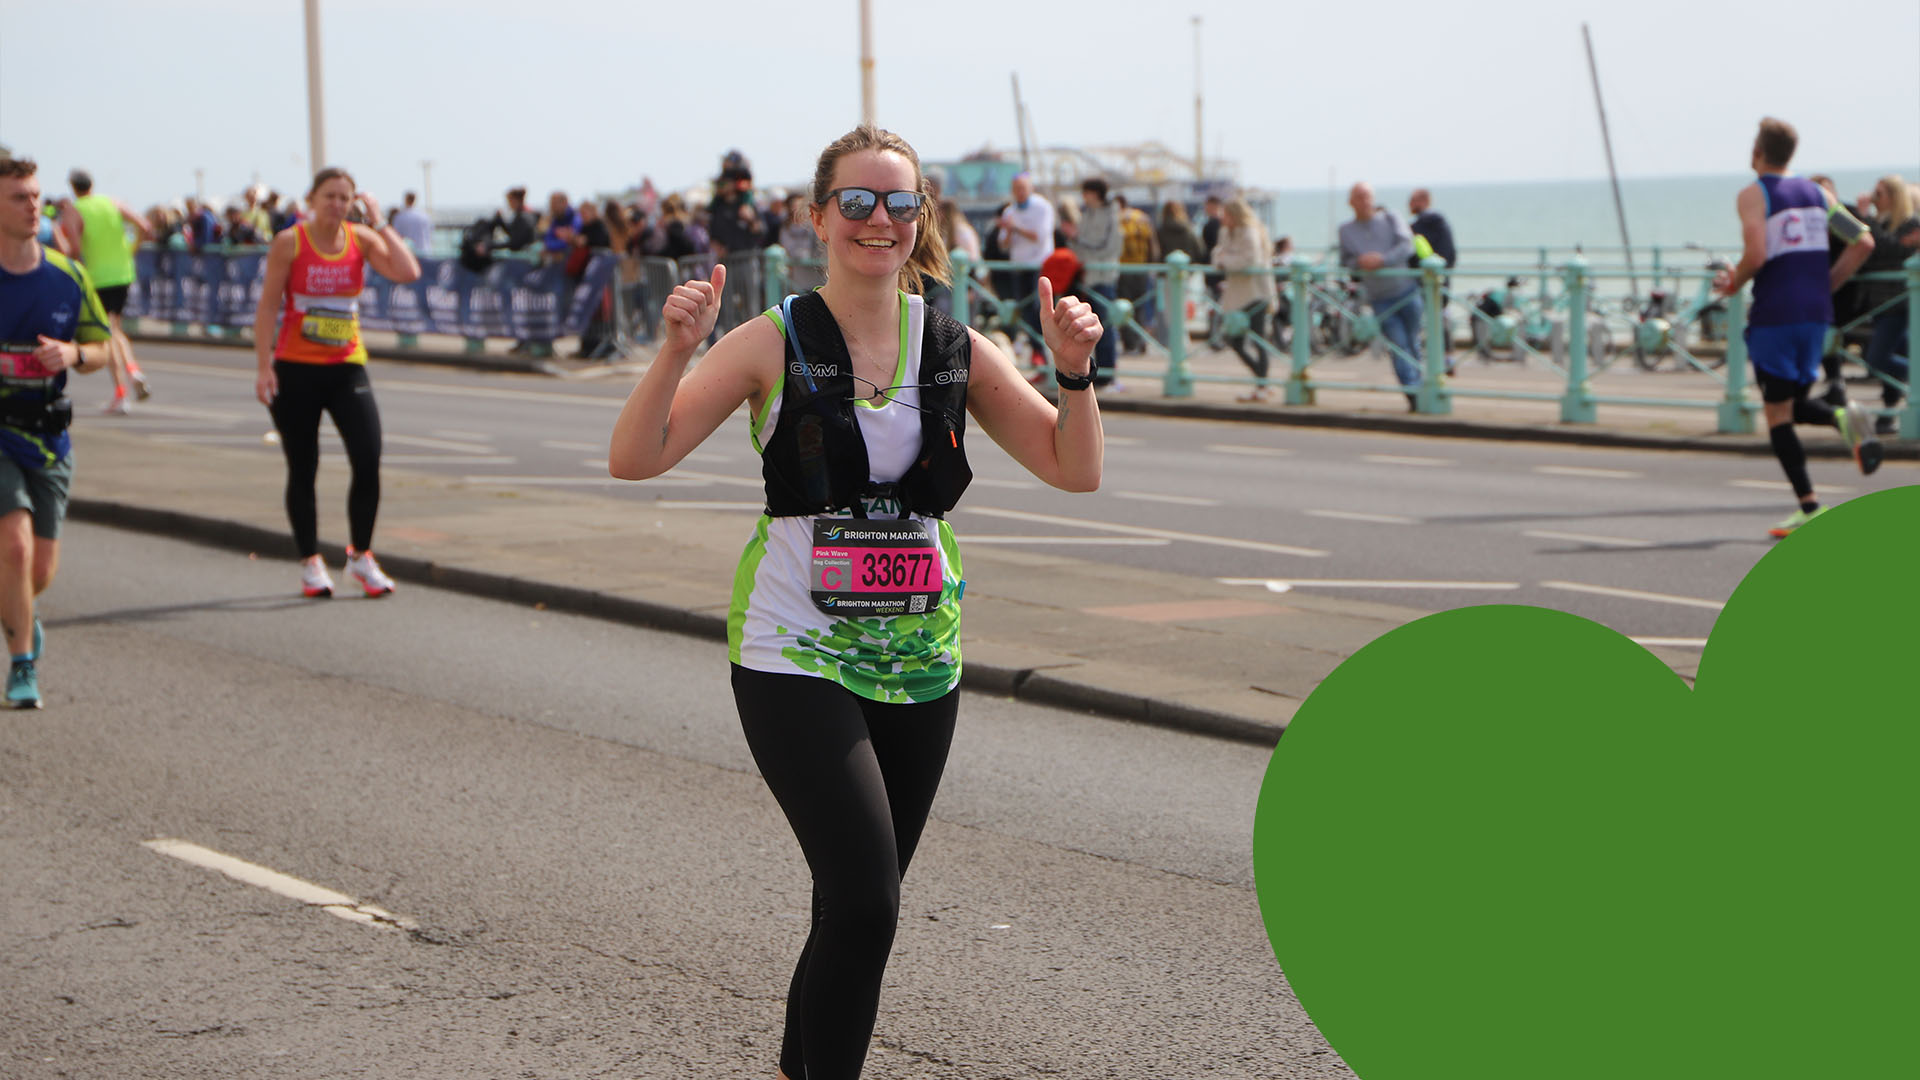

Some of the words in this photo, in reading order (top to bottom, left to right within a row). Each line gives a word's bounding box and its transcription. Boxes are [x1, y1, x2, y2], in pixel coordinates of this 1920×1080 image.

[844, 531, 888, 540] BRIGHTON
[821, 566, 843, 590] C
[861, 553, 934, 587] 33677
[871, 600, 906, 608] MARATHON
